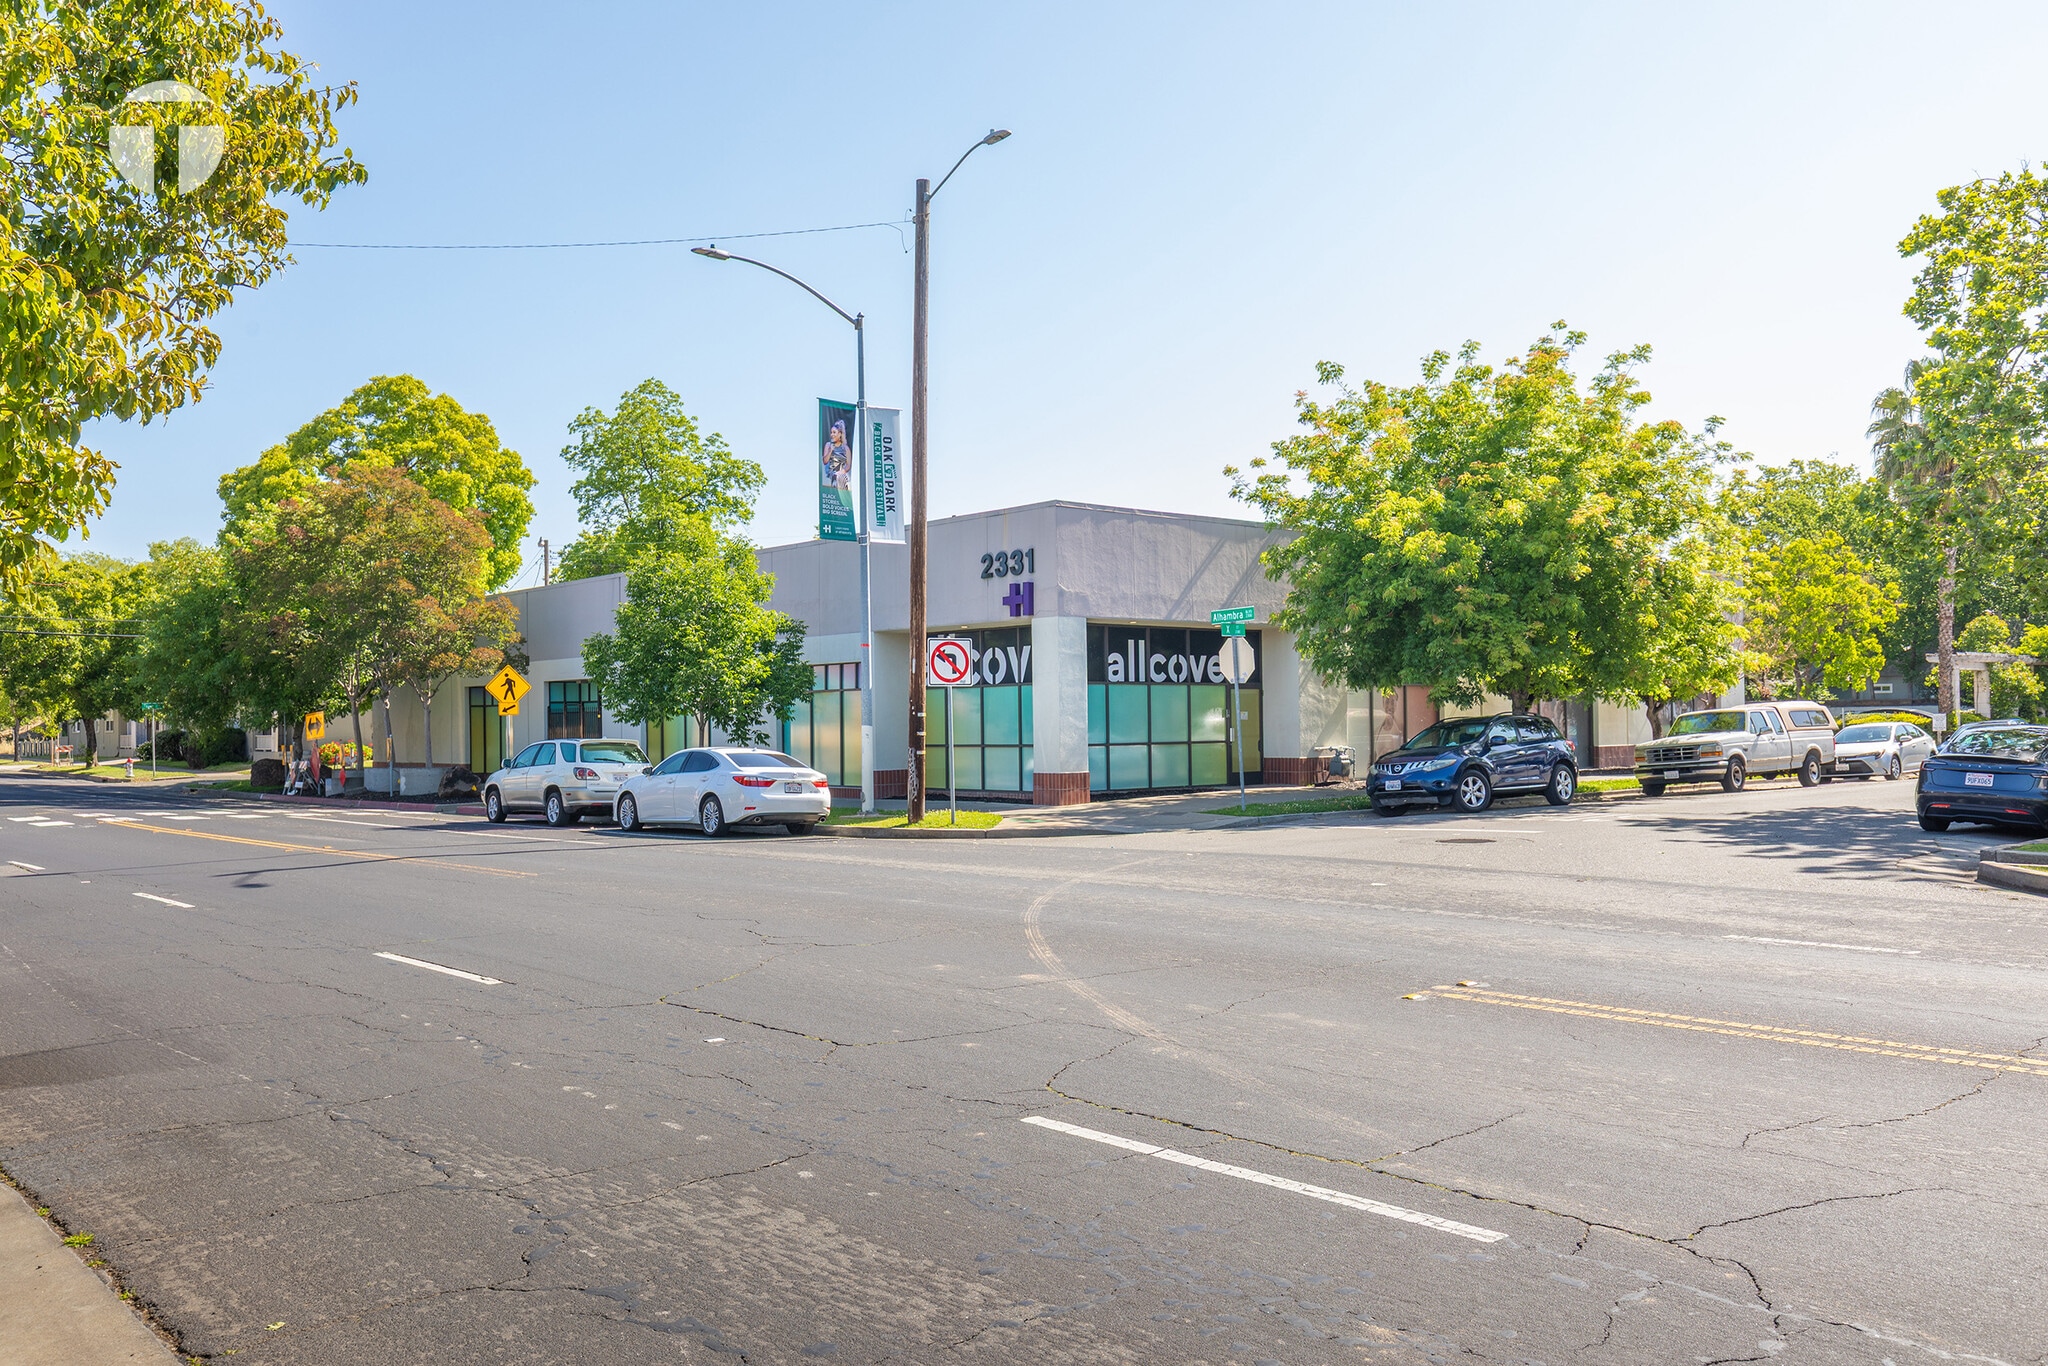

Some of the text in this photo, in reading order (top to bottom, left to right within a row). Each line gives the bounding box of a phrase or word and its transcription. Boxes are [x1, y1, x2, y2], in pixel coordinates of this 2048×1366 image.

[883, 436, 896, 513] OAK PARK
[876, 482, 885, 519] FESTIVAL
[981, 548, 1034, 579] 2331
[1213, 611, 1244, 622] Alhambra
[1108, 639, 1224, 684] allcove
